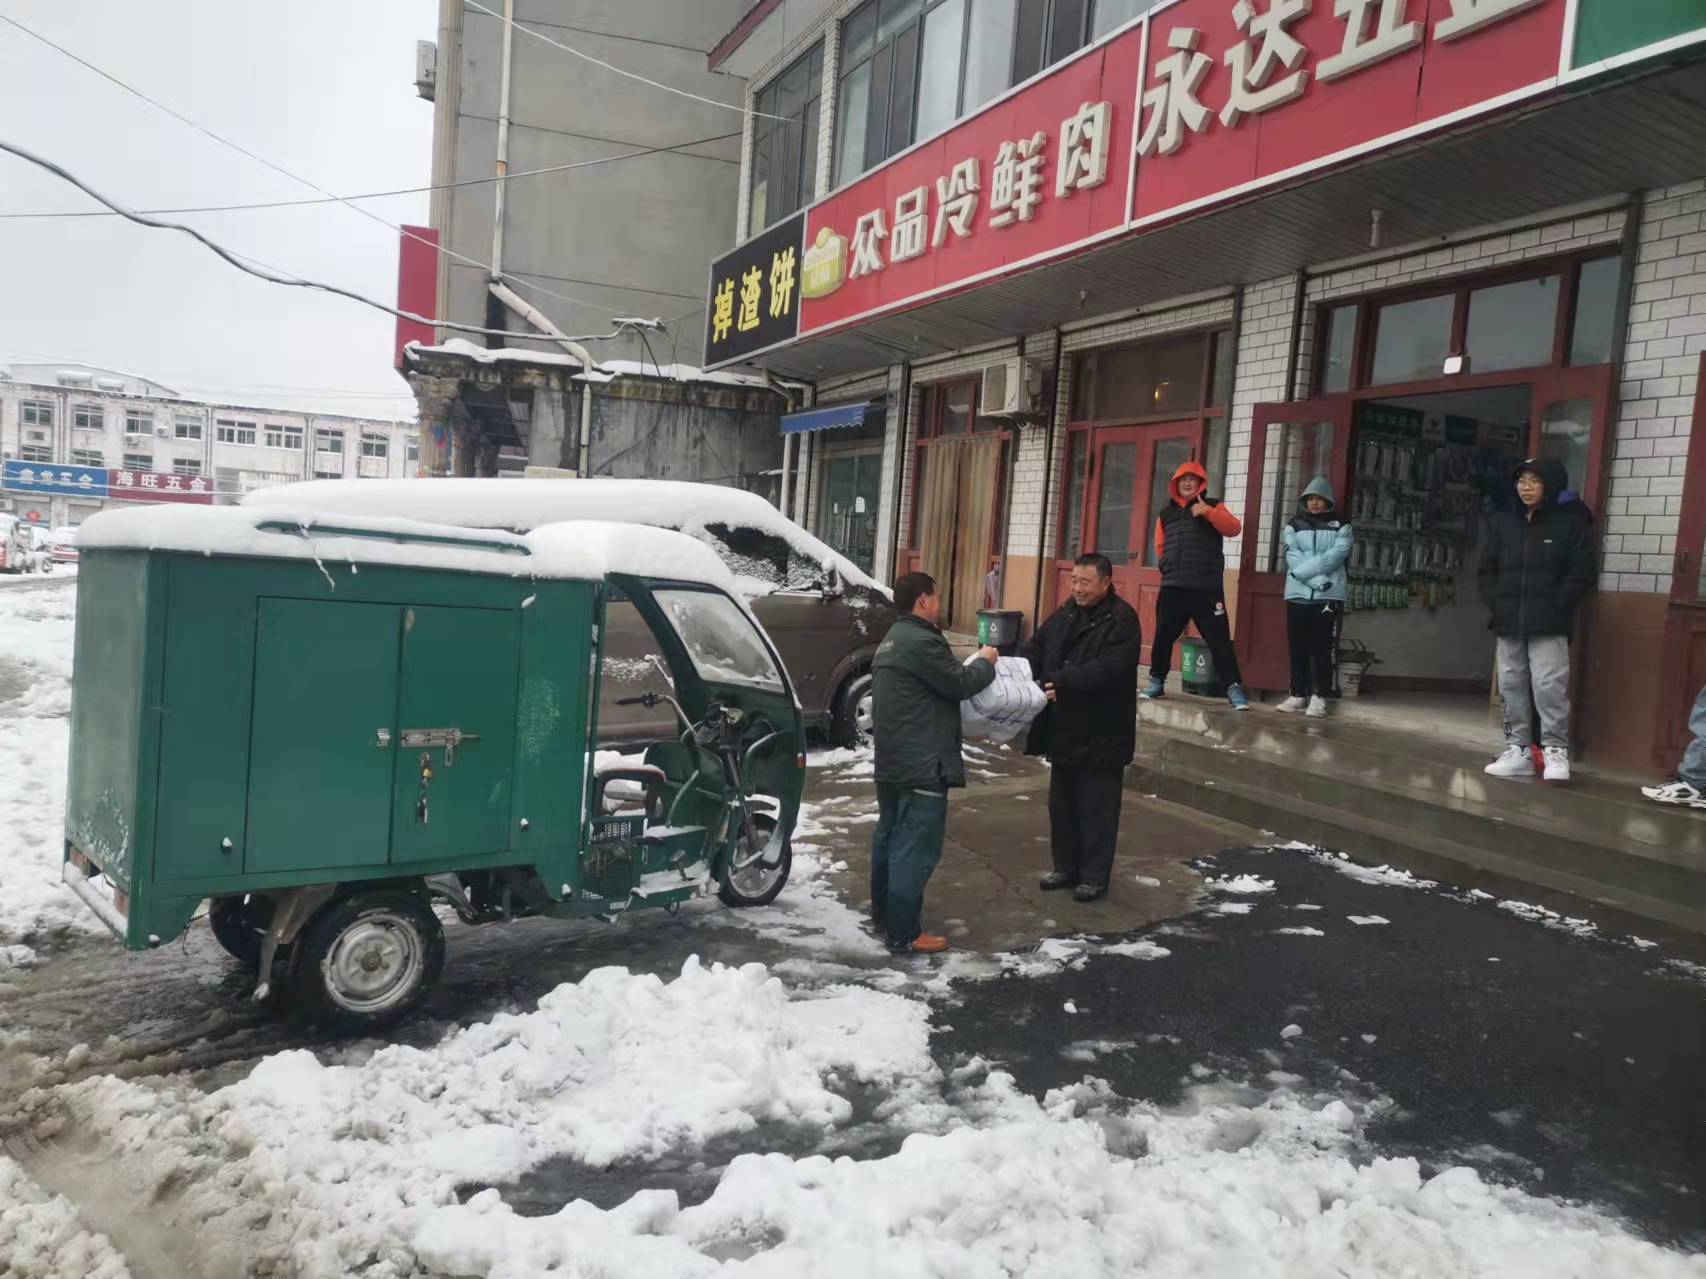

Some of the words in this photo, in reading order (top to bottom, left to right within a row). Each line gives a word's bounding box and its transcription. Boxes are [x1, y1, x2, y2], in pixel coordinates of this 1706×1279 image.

[848, 100, 1113, 280] 众品冷鲜肉
[712, 245, 796, 344] 掉渣饼
[116, 471, 207, 493] 海旺五金
